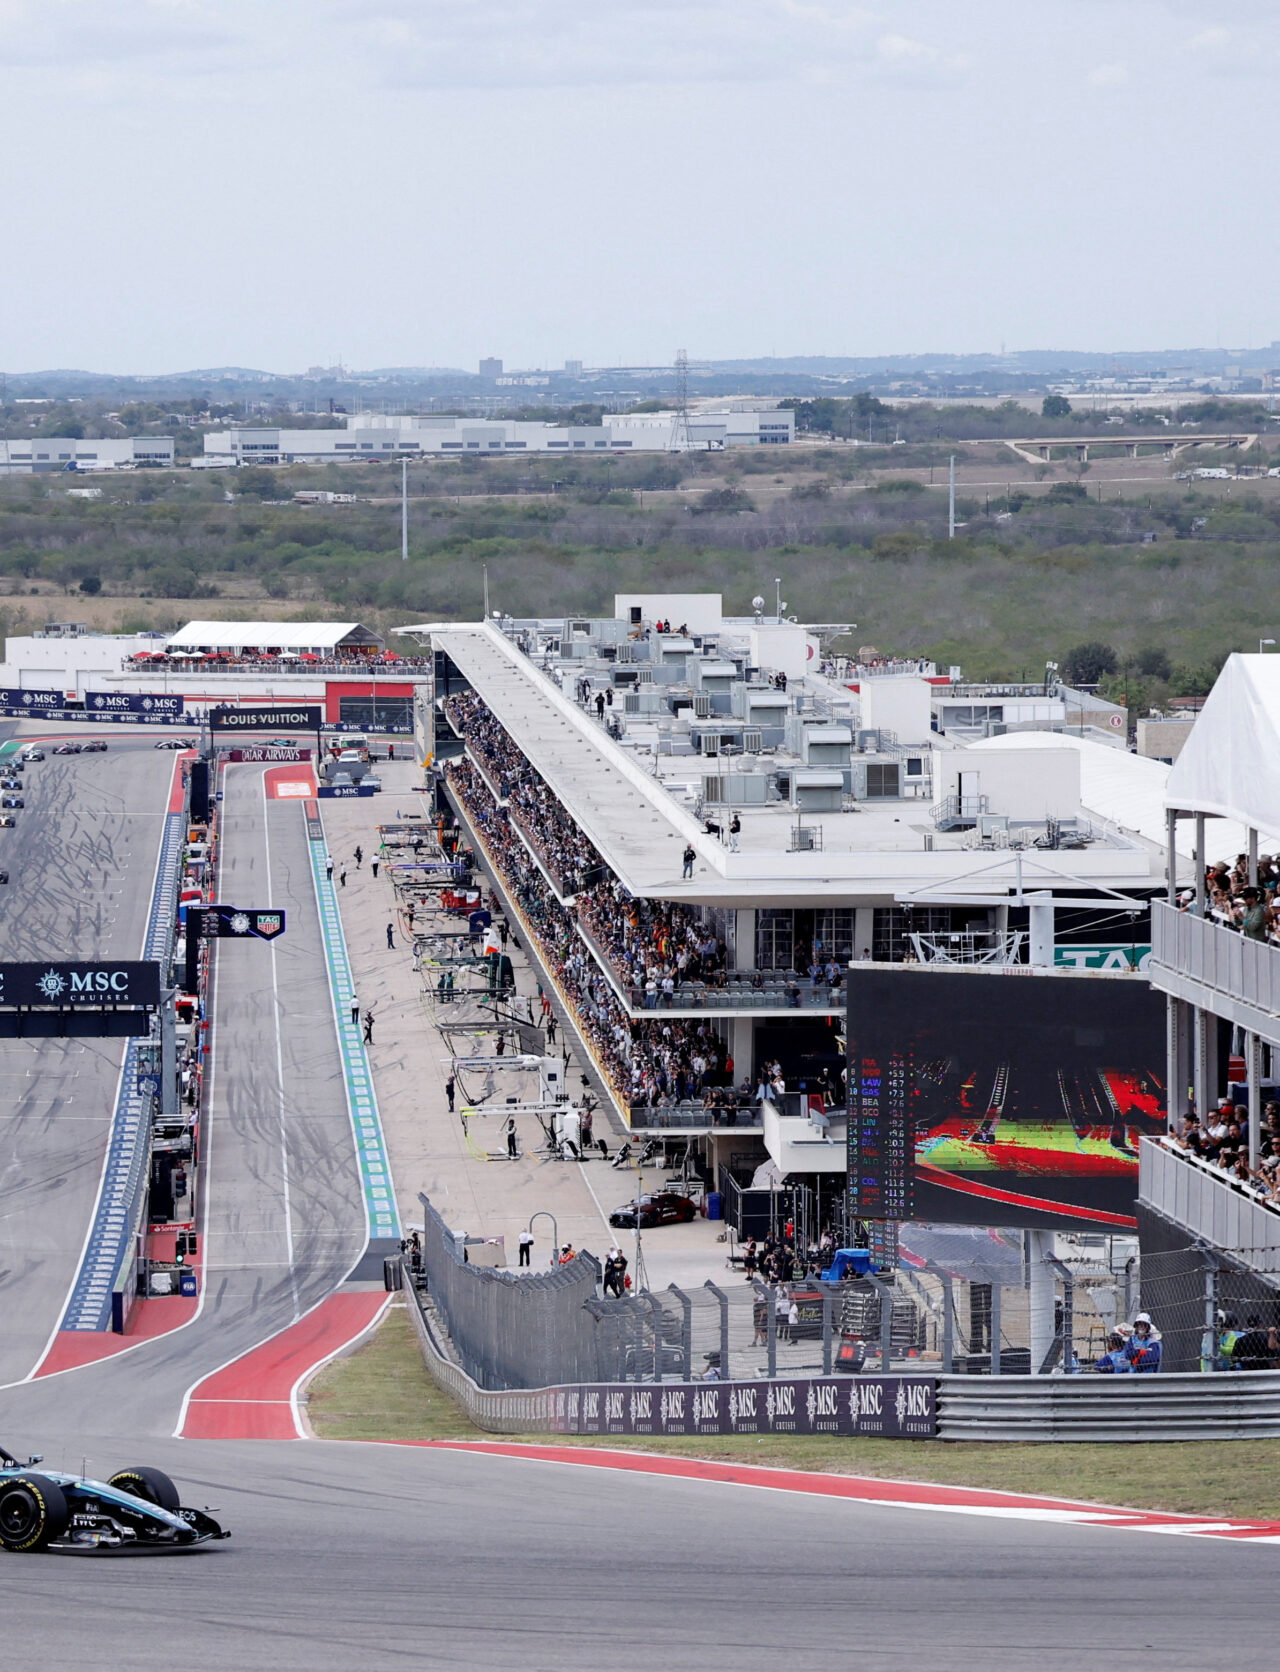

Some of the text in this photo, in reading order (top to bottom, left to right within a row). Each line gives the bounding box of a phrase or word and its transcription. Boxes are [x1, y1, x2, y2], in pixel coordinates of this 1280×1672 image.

[34, 694, 57, 704] MSC
[106, 697, 129, 706] MSC
[154, 699, 177, 708] MSC
[224, 713, 308, 725] LOUIS VUITTON
[242, 750, 263, 761] QATAR
[265, 749, 300, 760] AIRWAYS
[1063, 951, 1151, 971] TA
[70, 971, 129, 992] MSC
[611, 1392, 624, 1418] MSC
[637, 1392, 652, 1418] MSC
[668, 1392, 684, 1418] MSC
[701, 1390, 719, 1418] MSC
[737, 1388, 757, 1417] MSC
[776, 1386, 796, 1415] MSC
[816, 1386, 838, 1415] MSC
[860, 1385, 882, 1415] MSC
[907, 1385, 930, 1416] MSC
[668, 1424, 684, 1432] CRUISES
[701, 1424, 719, 1432] CRUISES
[737, 1423, 757, 1432] CRUISES
[776, 1422, 796, 1430] CRUISES
[816, 1422, 839, 1431] CRUISES
[860, 1422, 883, 1431] CRUISES
[907, 1423, 930, 1432] CRUISES
